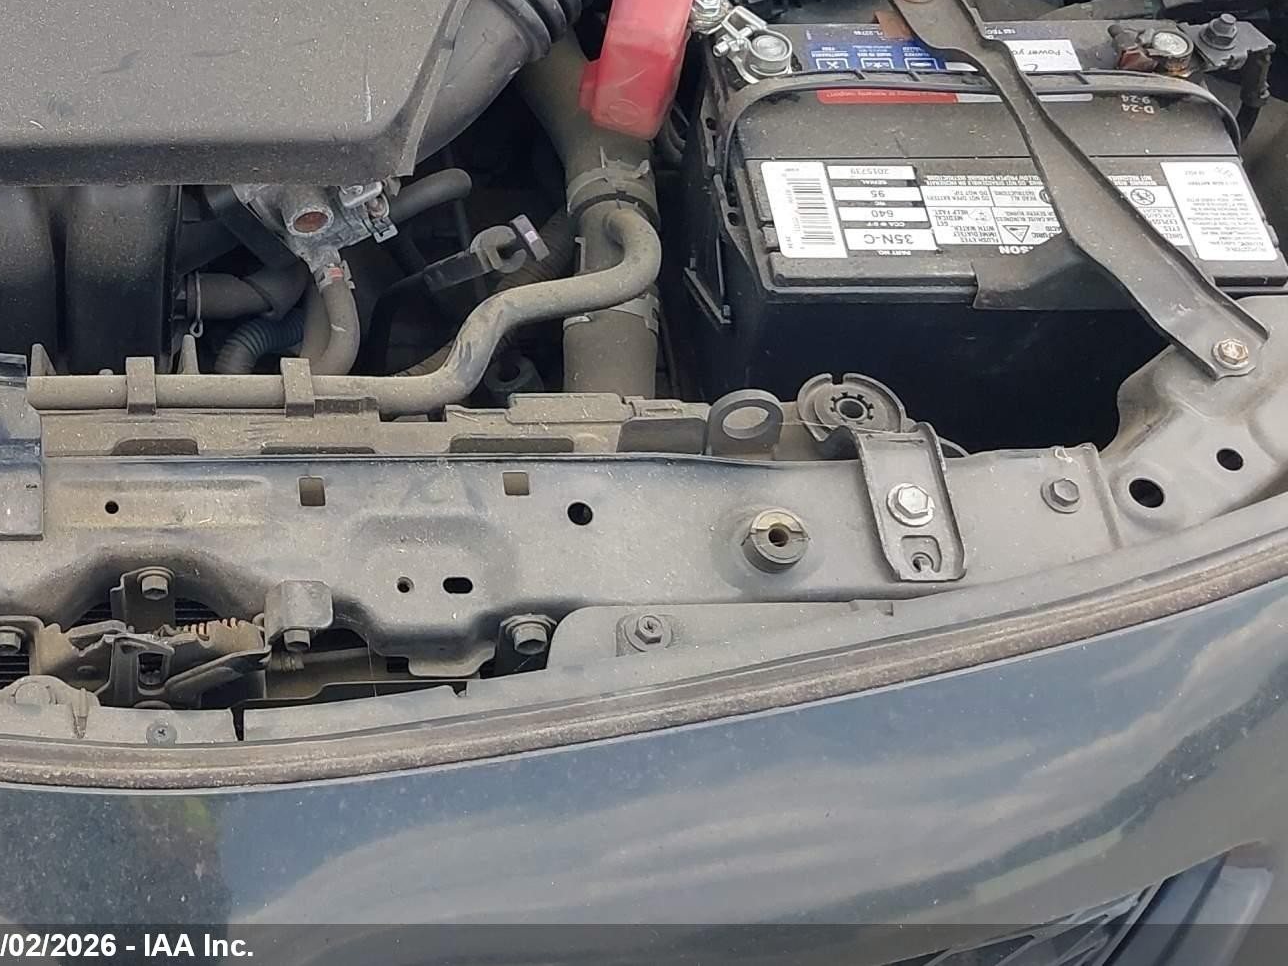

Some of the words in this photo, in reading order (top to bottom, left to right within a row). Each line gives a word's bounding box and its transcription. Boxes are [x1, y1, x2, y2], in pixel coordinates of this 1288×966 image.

[1011, 48, 1025, 56] yo
[870, 190, 885, 198] 95
[863, 234, 914, 245] 35N-C
